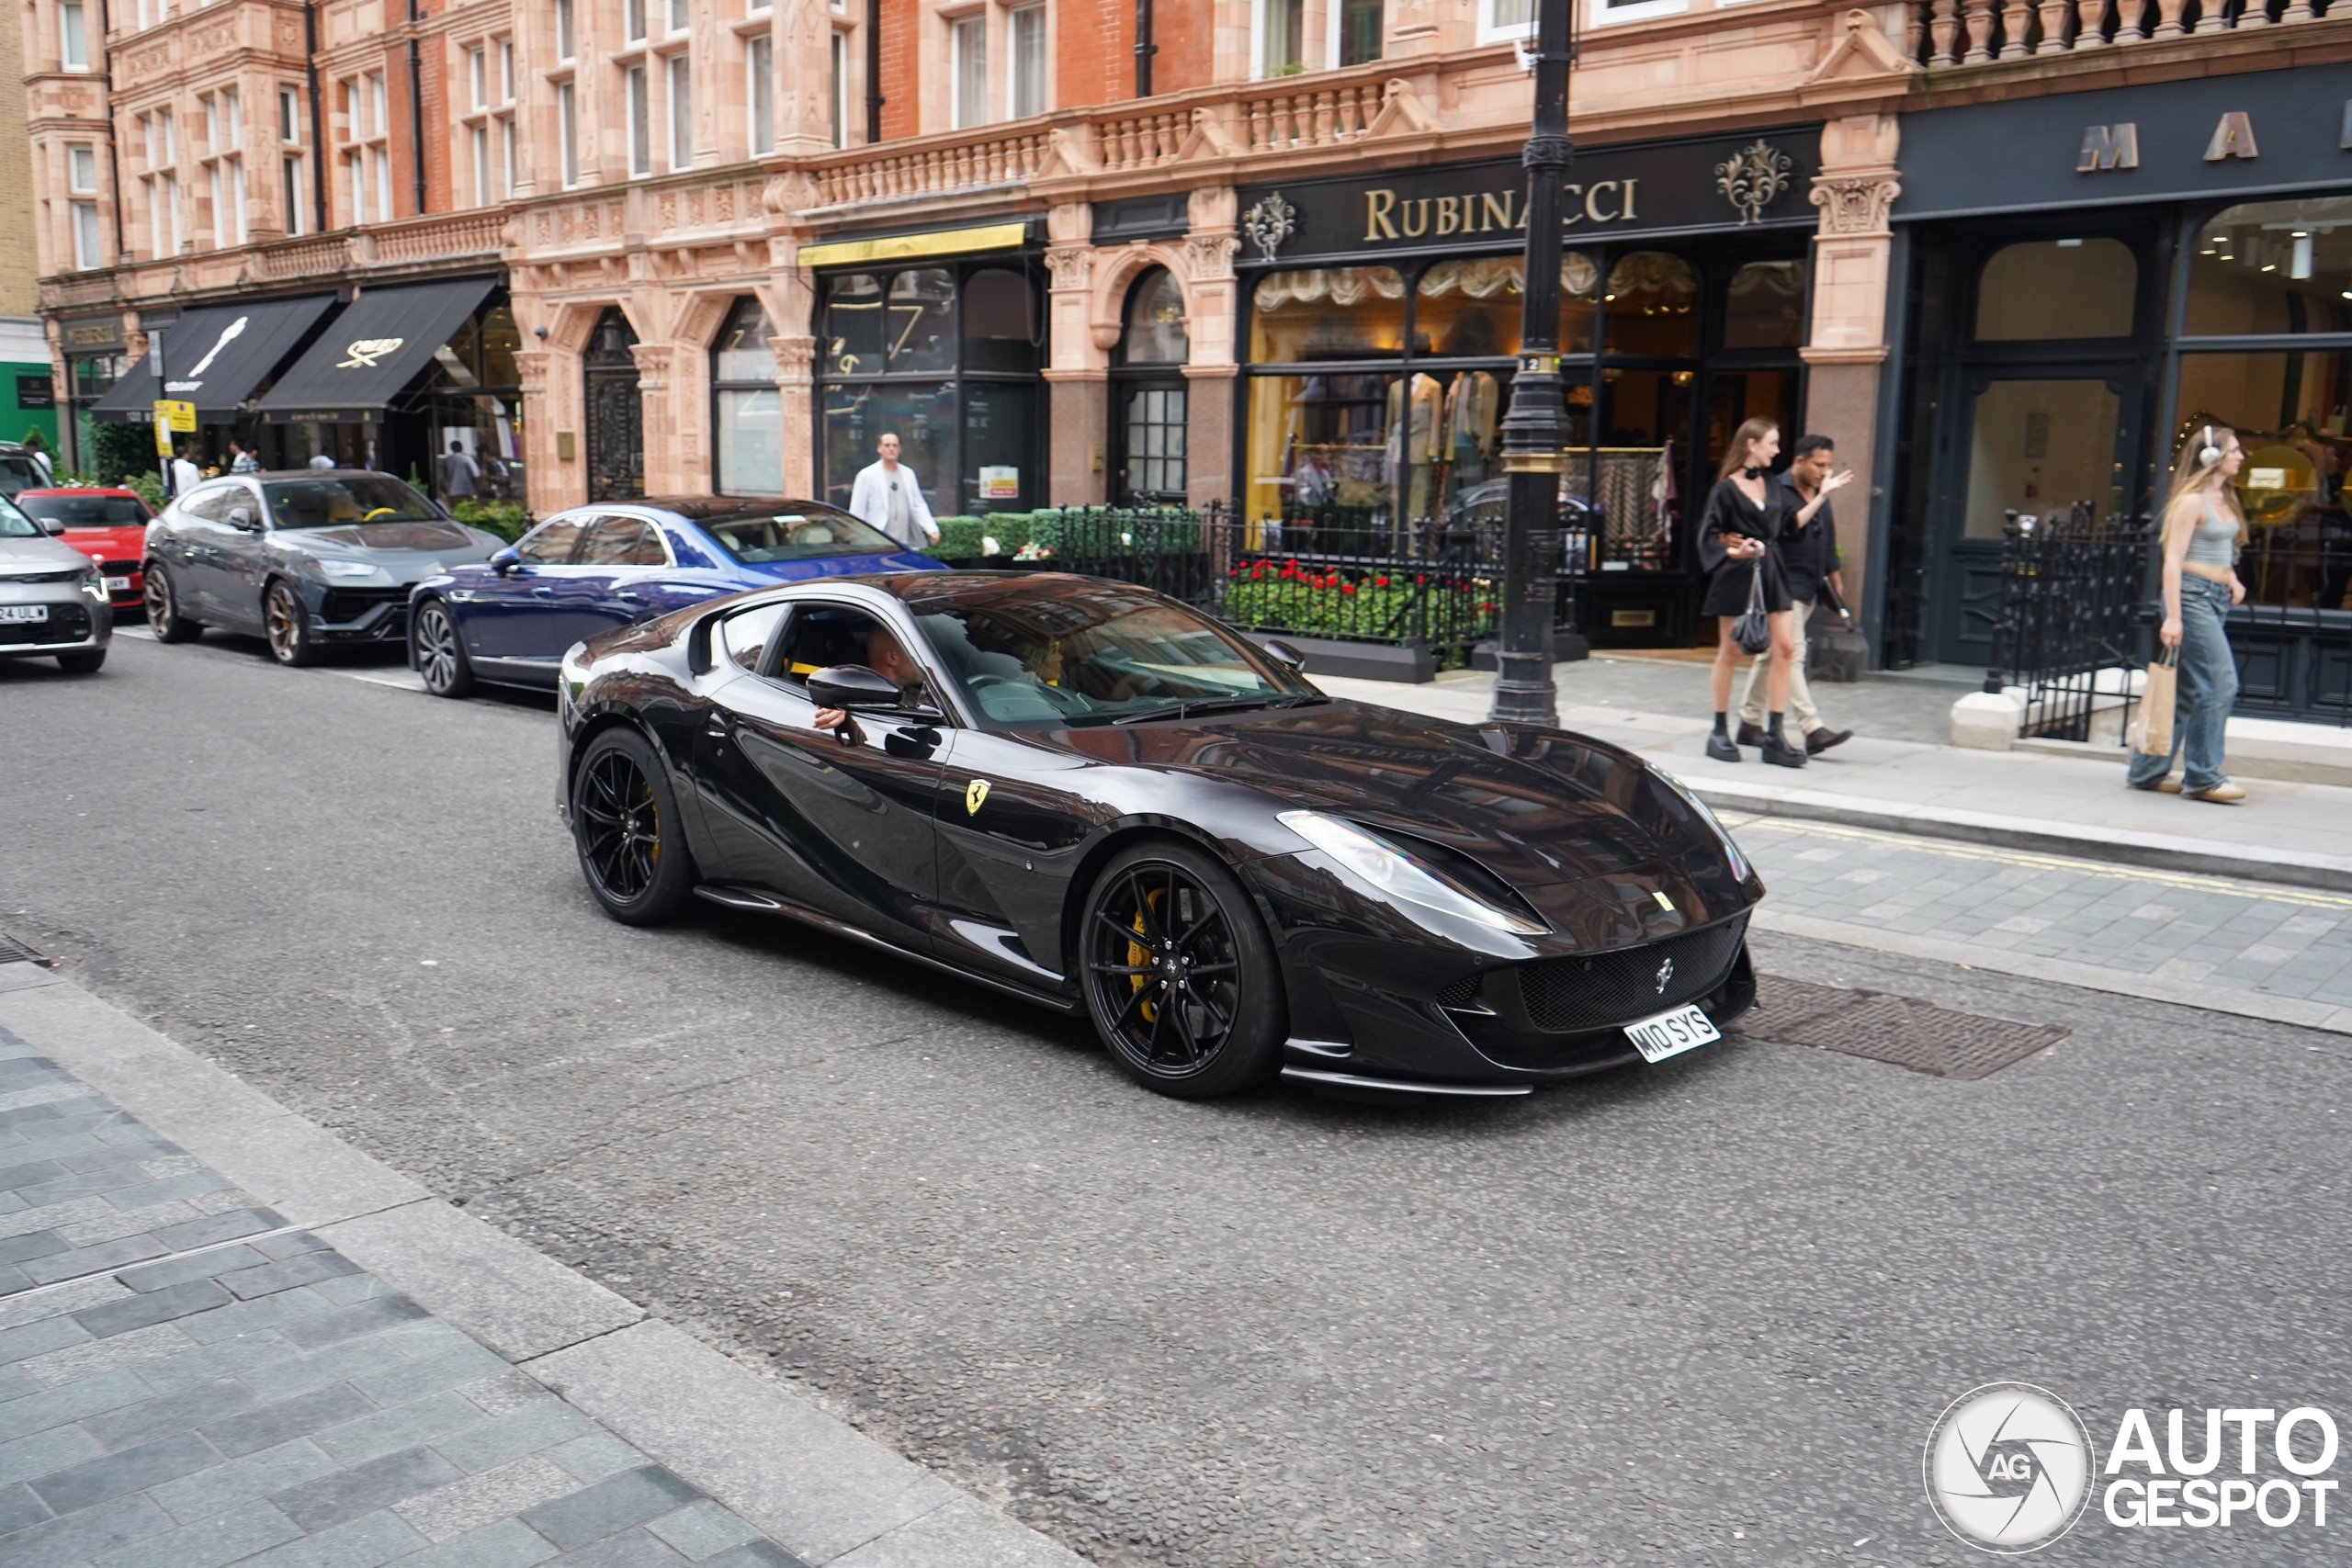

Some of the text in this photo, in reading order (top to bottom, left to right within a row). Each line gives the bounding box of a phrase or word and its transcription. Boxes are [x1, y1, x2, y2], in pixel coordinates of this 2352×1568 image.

[2075, 99, 2352, 173] MA
[1363, 178, 1639, 241] RUBINCCI
[1665, 1010, 1713, 1043] SYS
